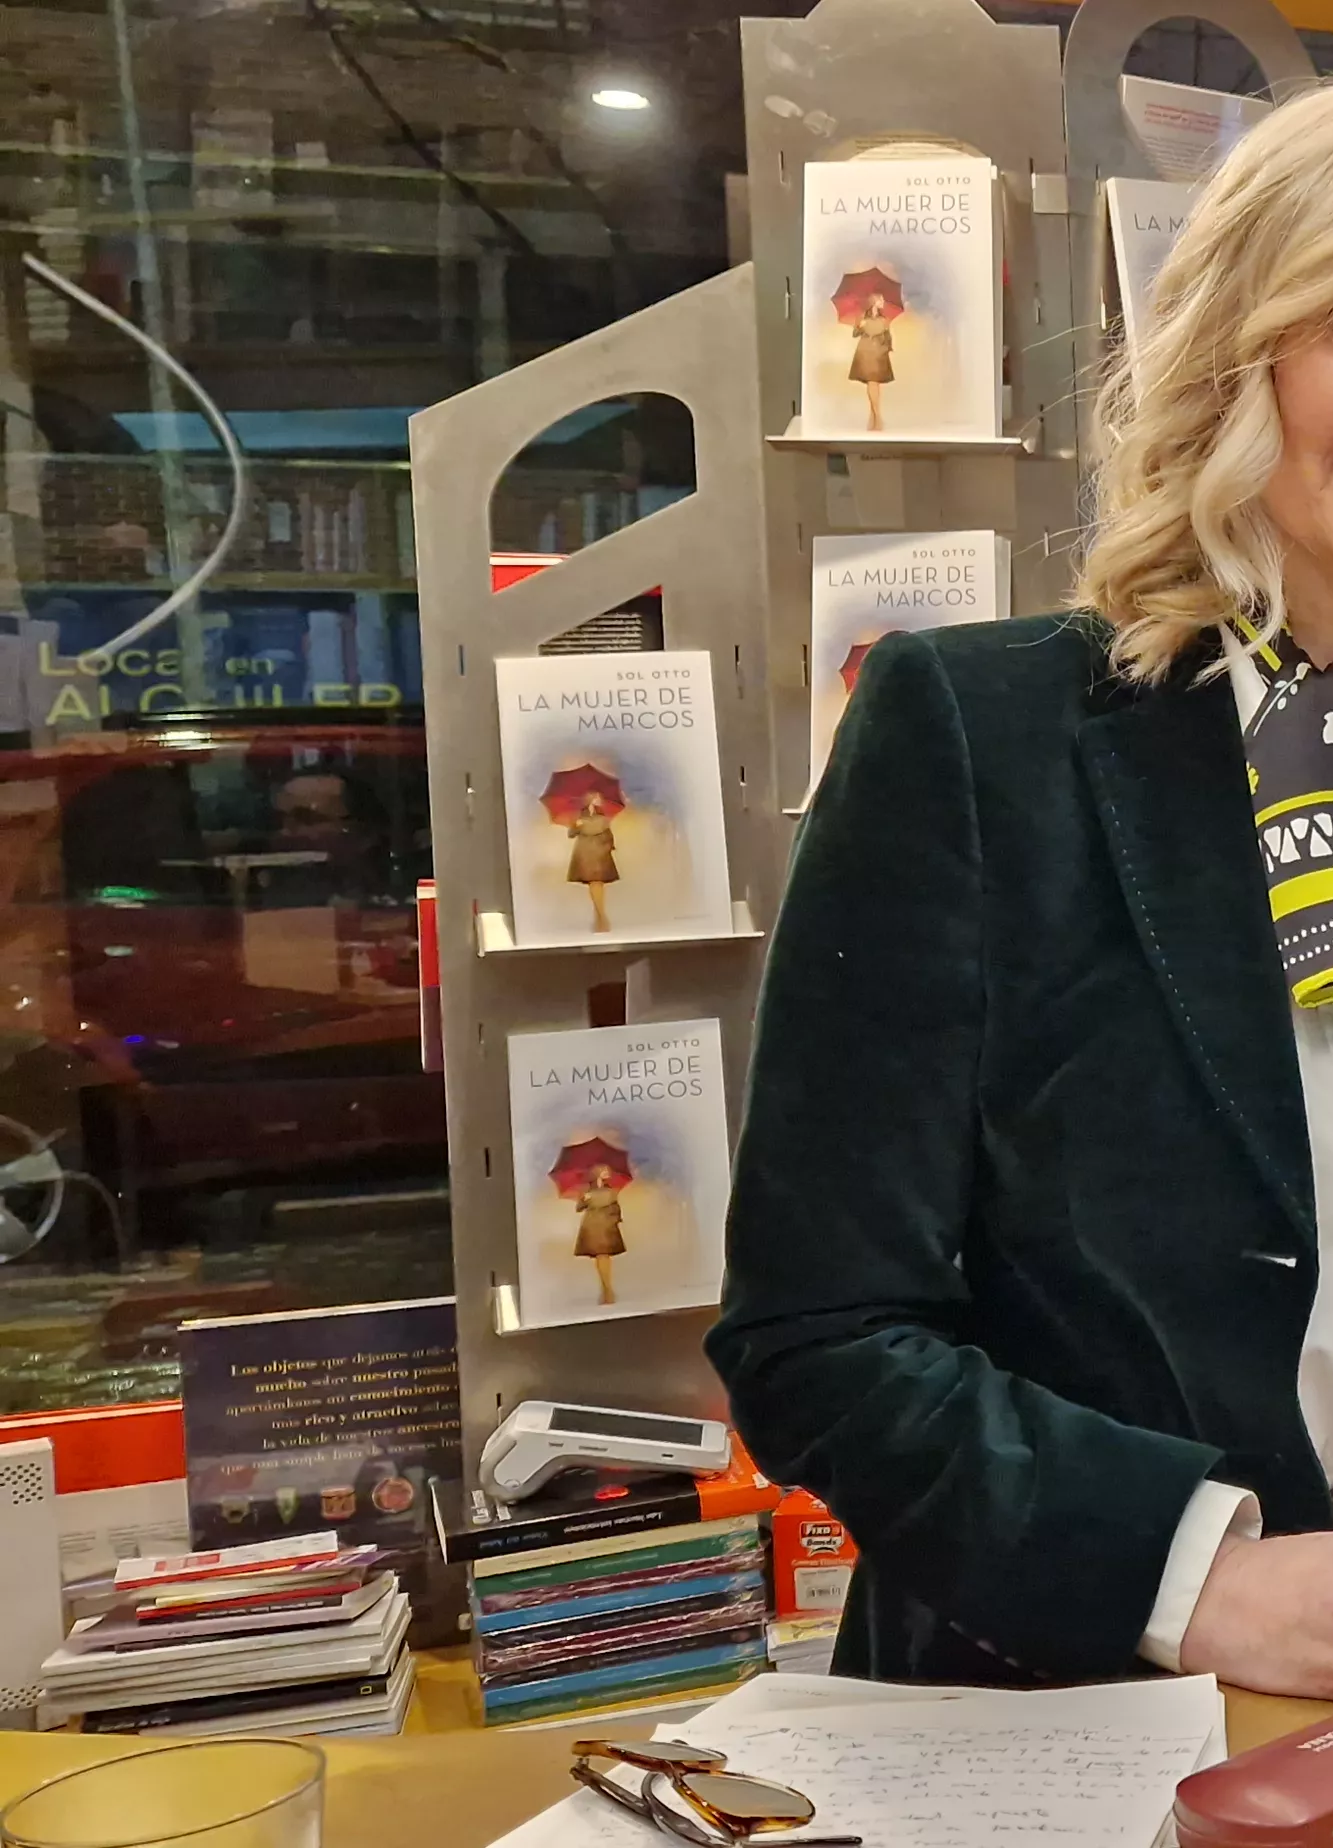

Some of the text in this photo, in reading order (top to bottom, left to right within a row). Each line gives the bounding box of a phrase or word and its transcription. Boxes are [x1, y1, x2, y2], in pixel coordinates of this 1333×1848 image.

[905, 175, 972, 187] SOL OTTO
[819, 192, 971, 216] LA MUJER DE
[868, 215, 972, 236] MARCOS
[1134, 212, 1161, 233] LA
[912, 548, 976, 559] SOL OTTO
[827, 565, 976, 587] LA MUJER DE
[876, 588, 977, 608] MARCOS
[225, 653, 276, 676] en
[616, 669, 692, 681] SOL OTTO
[517, 686, 693, 712] LA MUJER DE
[577, 709, 695, 732] MARCOS
[626, 1038, 701, 1053] SOL OTTO
[529, 1055, 702, 1088] LA MUJER DE
[587, 1078, 704, 1106] MARCOS
[263, 1359, 318, 1375] objetos
[255, 1369, 409, 1393] mucho nuestro
[305, 1404, 418, 1426] rico y atractivo
